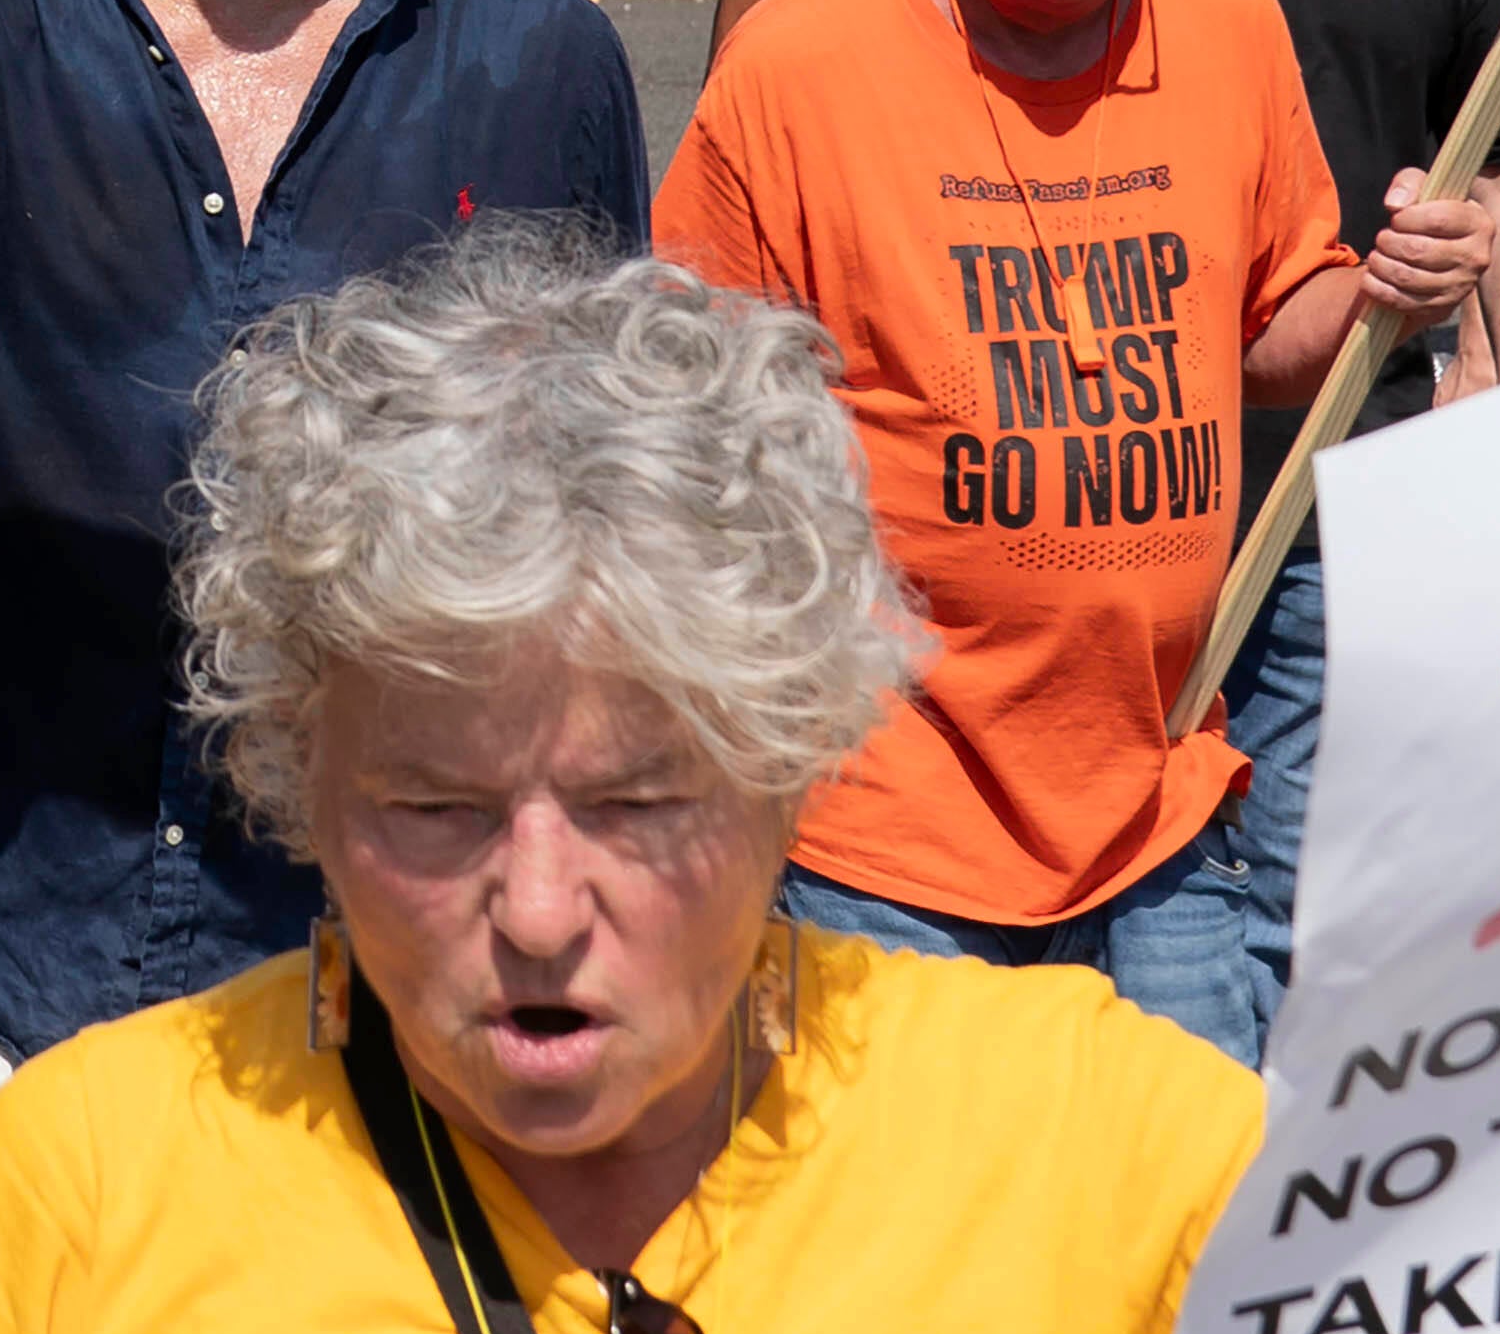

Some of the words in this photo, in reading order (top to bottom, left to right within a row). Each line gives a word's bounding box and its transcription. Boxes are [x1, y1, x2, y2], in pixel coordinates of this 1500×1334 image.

[941, 166, 1172, 204] RefuseFascism.org
[950, 233, 1189, 334] TRUMP
[991, 331, 1184, 429] MUST
[944, 433, 1036, 529] GO
[1064, 420, 1222, 528] NOW!
[1271, 1136, 1456, 1237] NO
